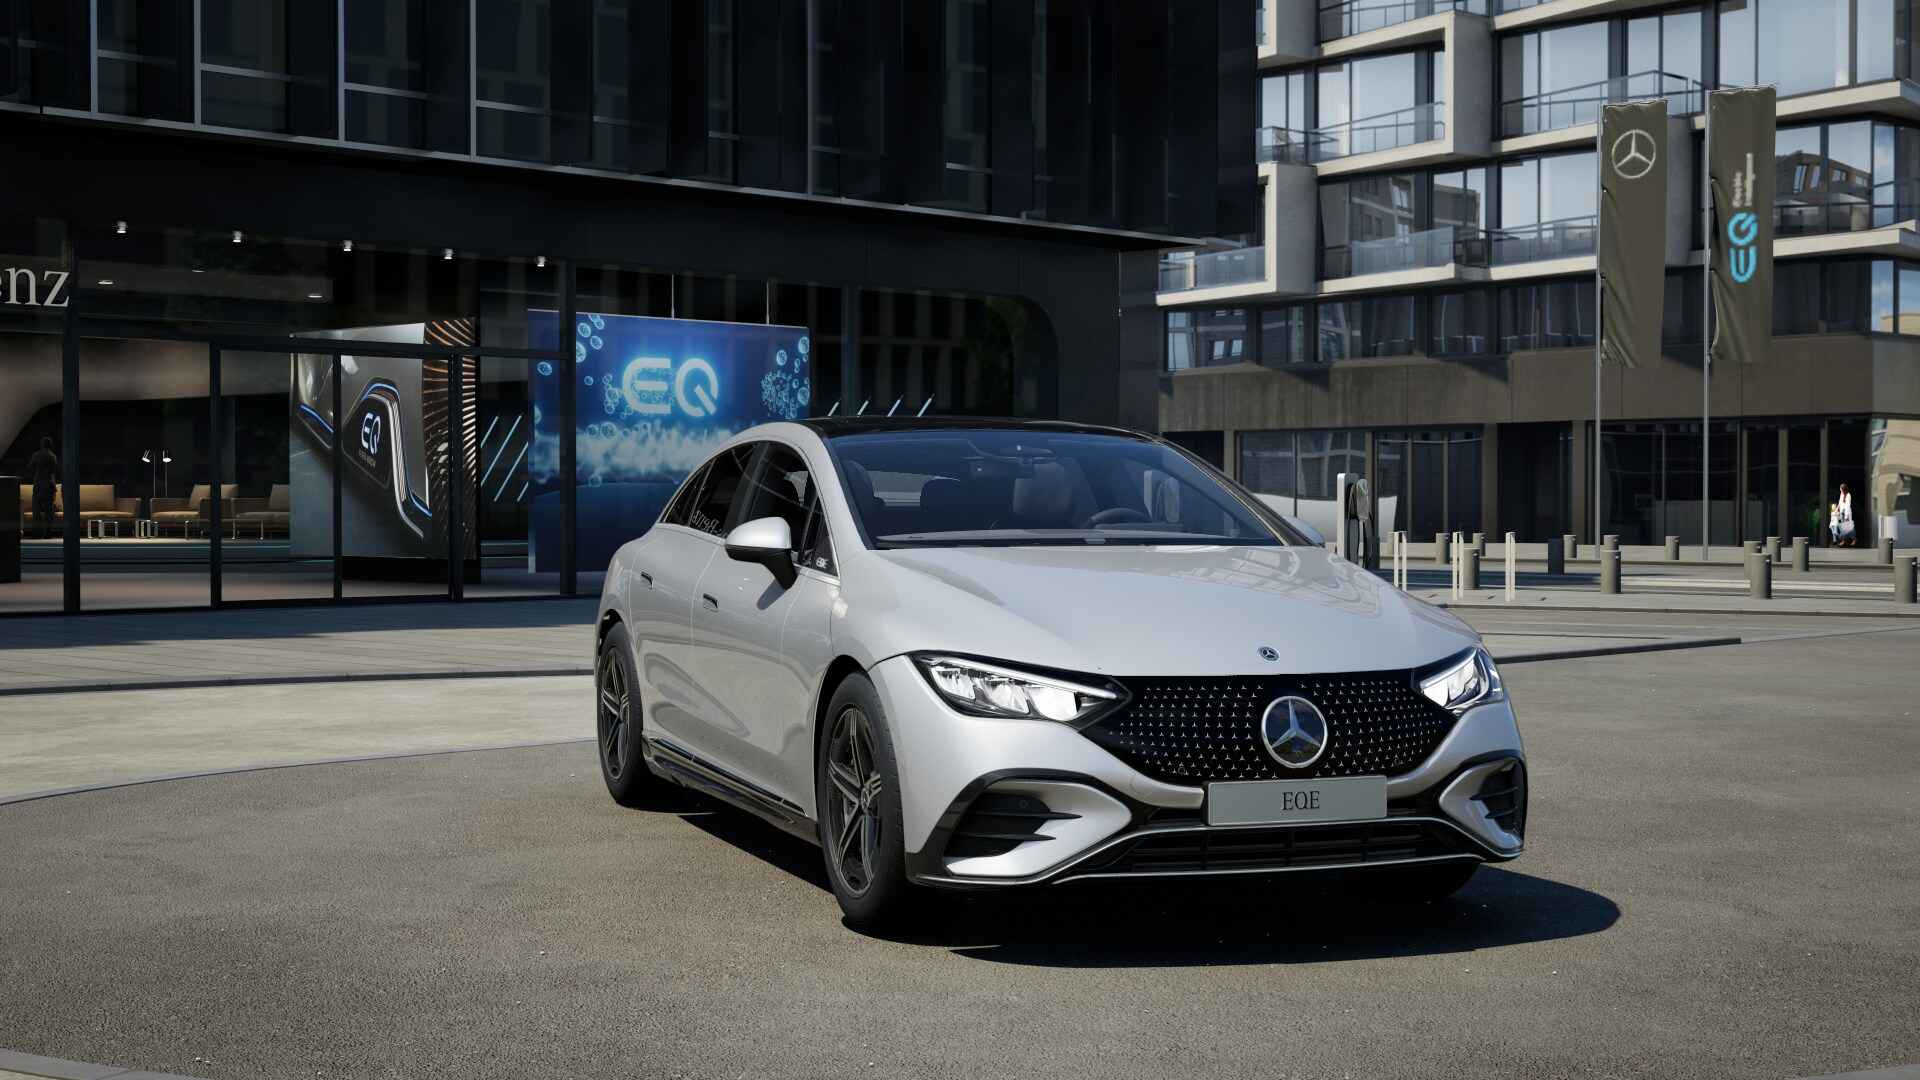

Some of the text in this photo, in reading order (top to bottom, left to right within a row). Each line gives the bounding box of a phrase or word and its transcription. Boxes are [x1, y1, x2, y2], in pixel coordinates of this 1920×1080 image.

[1727, 211, 1758, 283] EQ
[0, 267, 70, 308] nz
[622, 357, 719, 417] EQ
[361, 412, 381, 455] EQ
[1282, 790, 1320, 810] EQE
